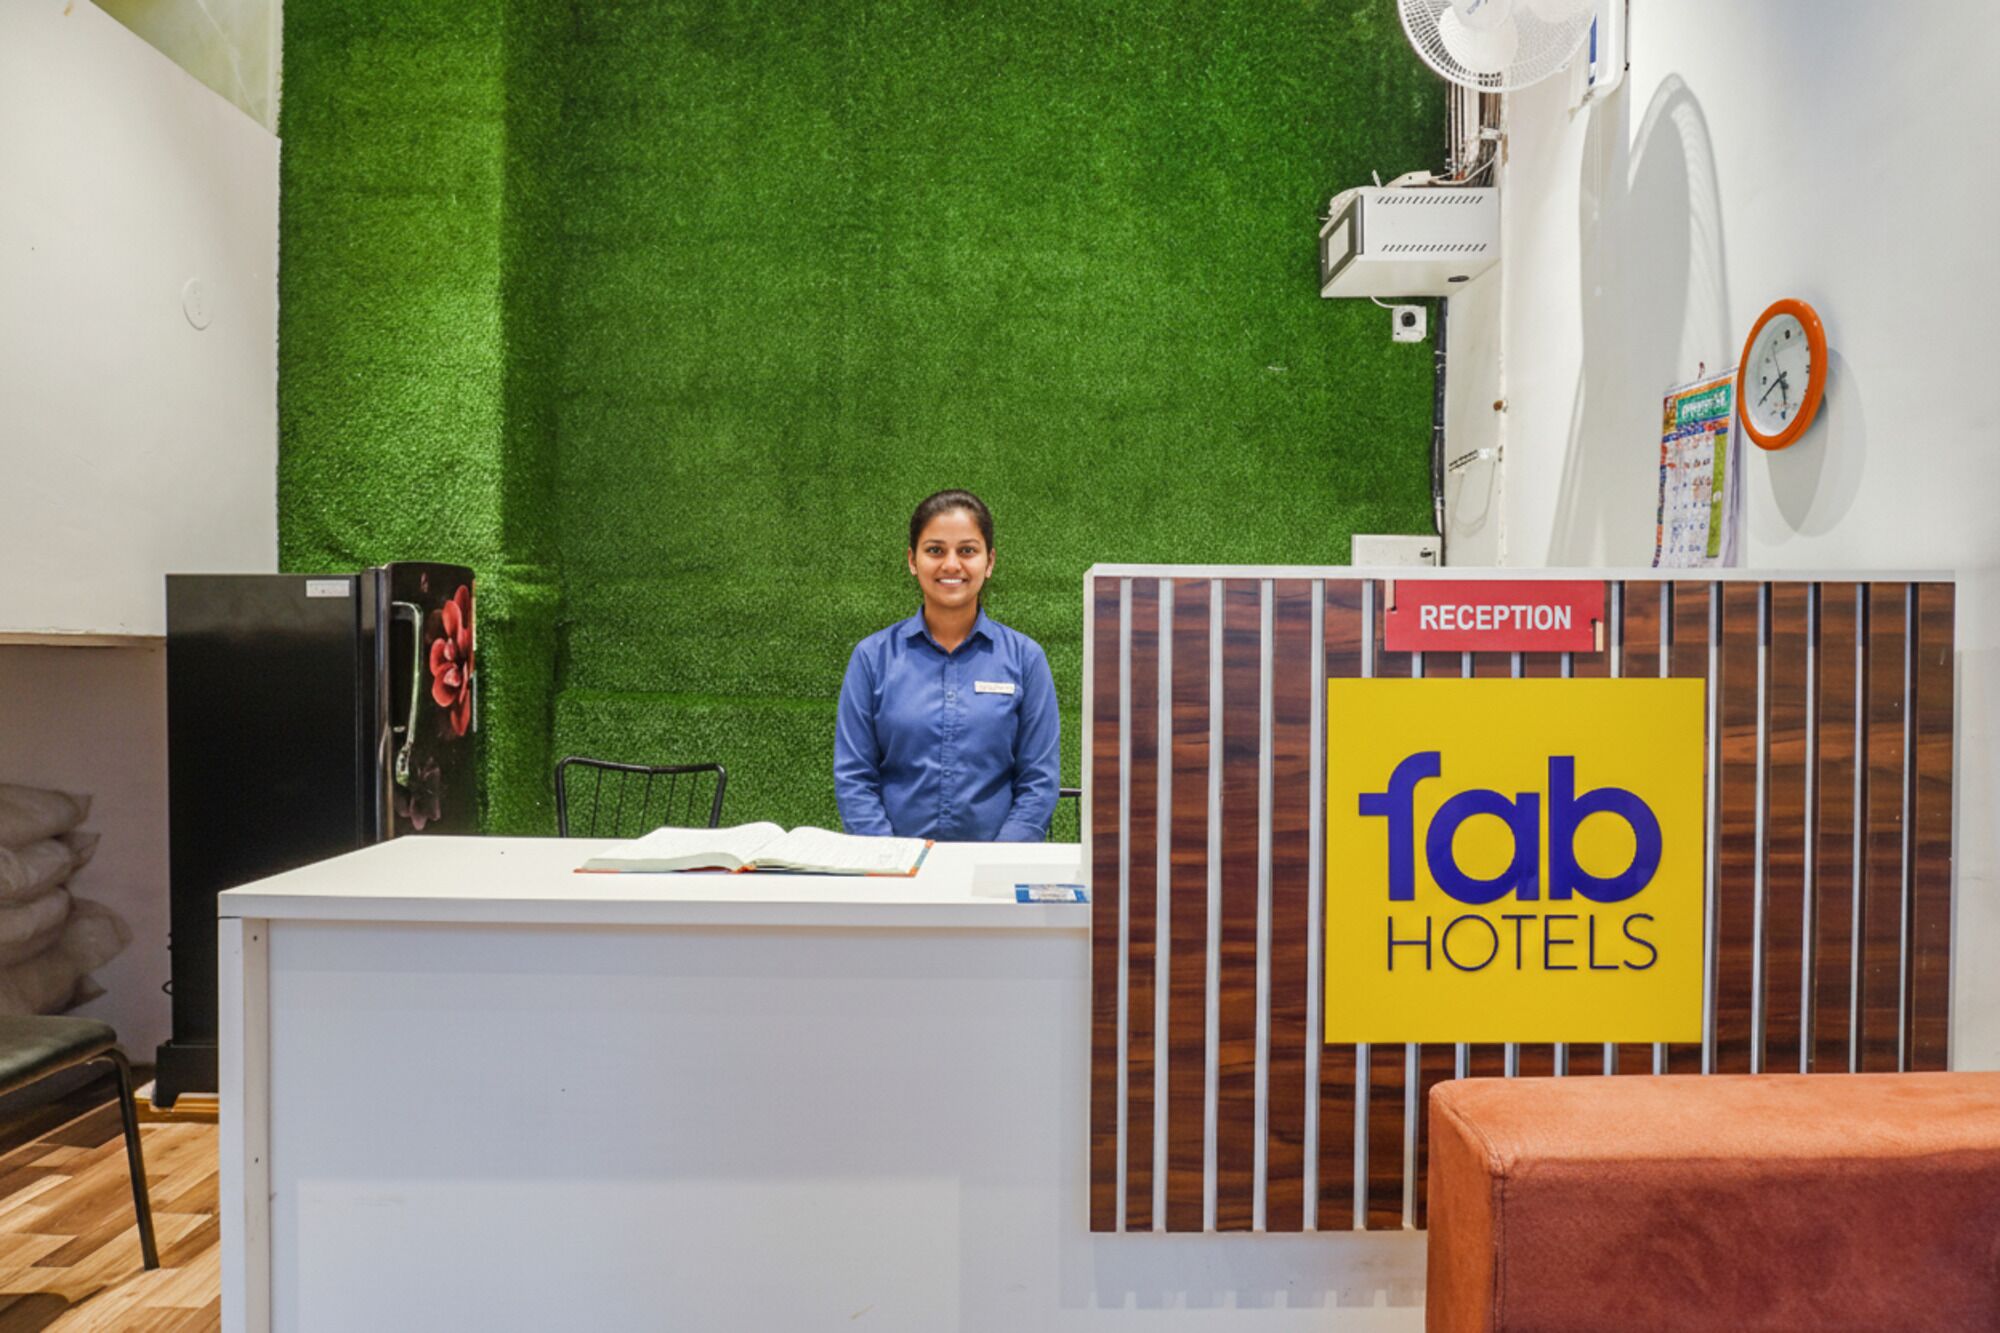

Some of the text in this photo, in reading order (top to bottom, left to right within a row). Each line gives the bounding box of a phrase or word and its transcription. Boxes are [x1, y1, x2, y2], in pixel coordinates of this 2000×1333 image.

[1420, 604, 1571, 630] RECEPTION
[1358, 751, 1663, 905] fab
[1387, 912, 1658, 972] HOTELS
